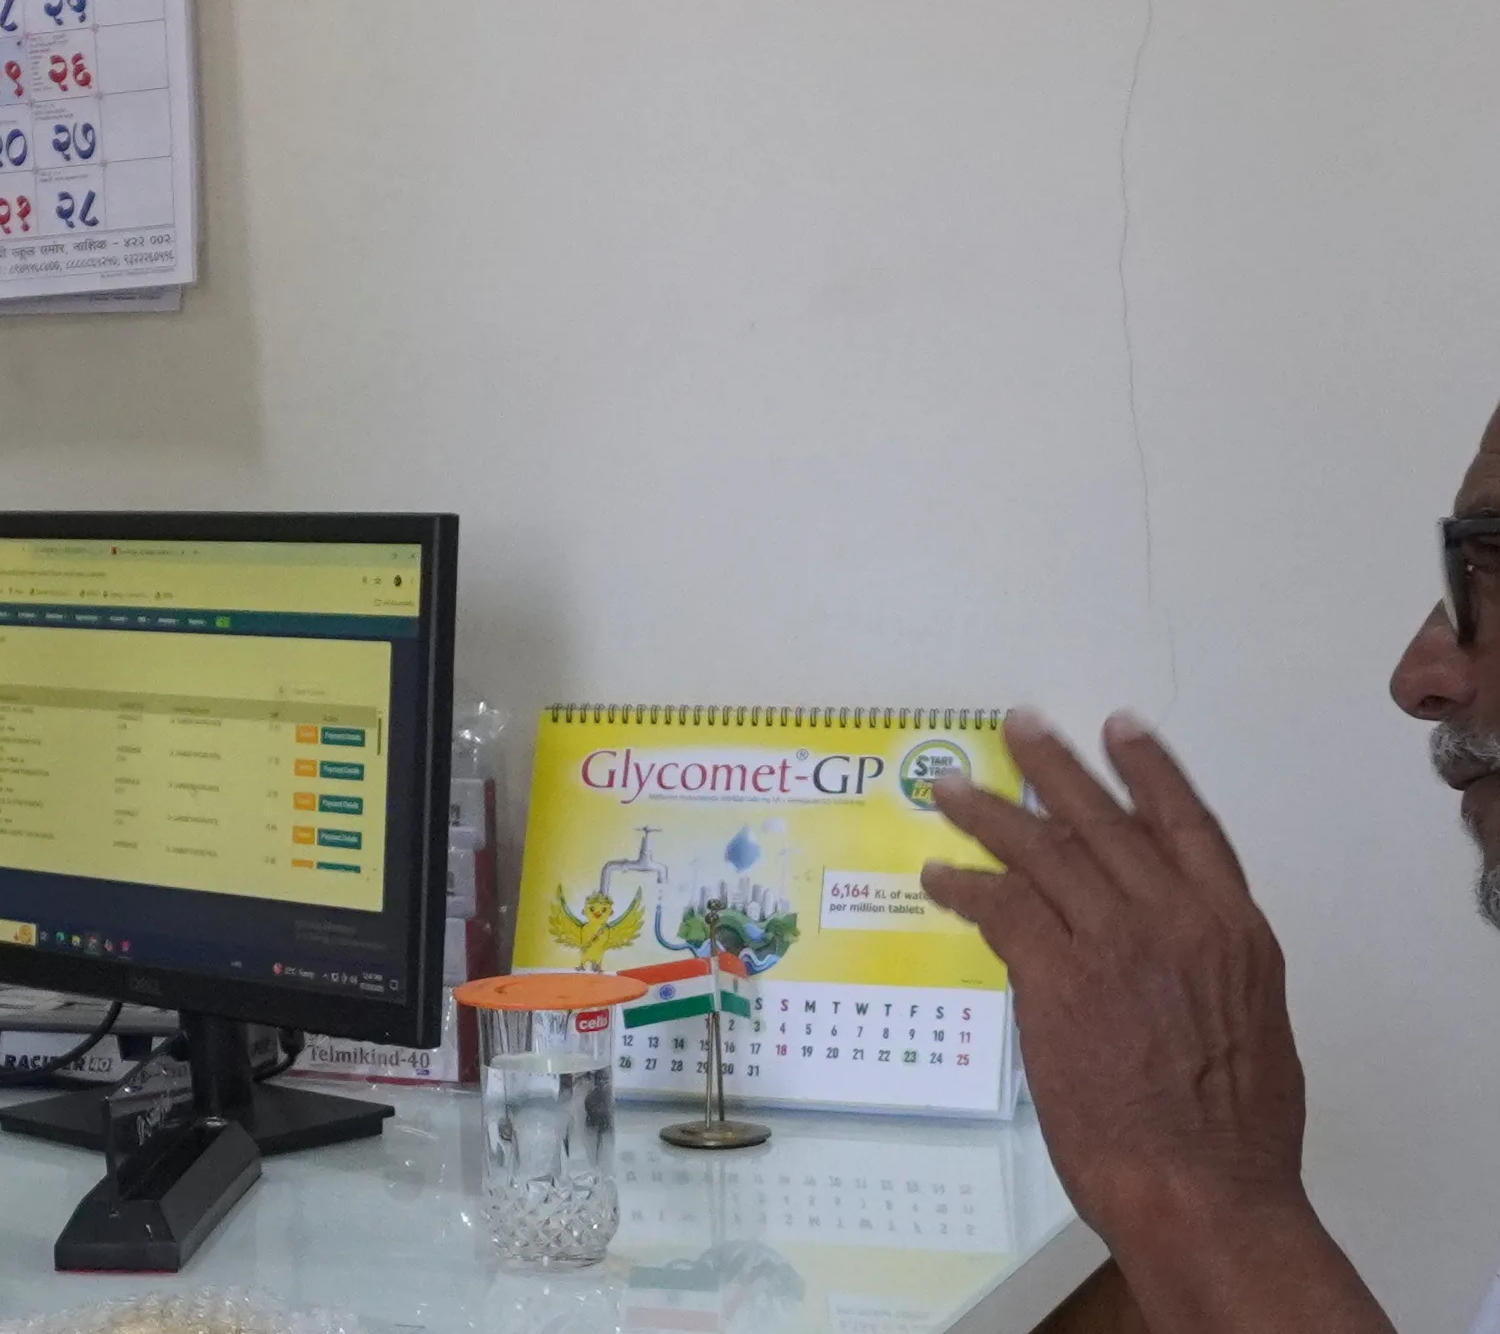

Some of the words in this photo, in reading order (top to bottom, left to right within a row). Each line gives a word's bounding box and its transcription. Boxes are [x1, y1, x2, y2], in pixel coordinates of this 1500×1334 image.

[48, 52, 92, 92] २६
[51, 122, 96, 163] २७
[55, 190, 99, 229] २८
[831, 884, 870, 899] 6,164
[874, 889, 887, 898] KL
[890, 888, 902, 900] of
[904, 890, 931, 900] wate
[830, 904, 847, 915] per
[849, 902, 885, 913] million
[889, 904, 925, 915] tablets
[755, 998, 763, 1011] S
[781, 999, 788, 1011] S
[805, 1000, 816, 1013] M
[832, 1001, 841, 1014] T
[856, 1003, 869, 1015] W
[883, 1004, 892, 1016] T
[910, 1005, 918, 1017] F
[936, 1006, 945, 1019] S
[962, 1008, 972, 1020] S
[729, 1019, 734, 1031] 2
[754, 1021, 760, 1032] 3
[780, 1022, 786, 1033] 4
[805, 1023, 812, 1035] 5
[831, 1025, 837, 1036] 6
[857, 1026, 863, 1037] 7
[883, 1027, 889, 1038] 8
[909, 1029, 915, 1040] 9
[933, 1030, 944, 1041] 10
[960, 1031, 971, 1043] 11
[307, 1044, 431, 1068] Telmikind-40
[623, 1035, 633, 1047] 12
[648, 1037, 658, 1048] 13
[673, 1038, 685, 1049] 14
[724, 1041, 735, 1053] 16
[750, 1043, 761, 1055] 17
[776, 1044, 787, 1056] 18
[801, 1045, 812, 1057] 19
[826, 1046, 838, 1059] 20
[852, 1048, 864, 1060] 21
[878, 1049, 890, 1061] 22
[904, 1051, 917, 1063] 23
[930, 1052, 943, 1065] 24
[956, 1053, 970, 1066] 25
[619, 1056, 631, 1068] 26
[645, 1058, 657, 1070] 27
[671, 1059, 683, 1072] 28
[748, 1064, 759, 1076] 31
